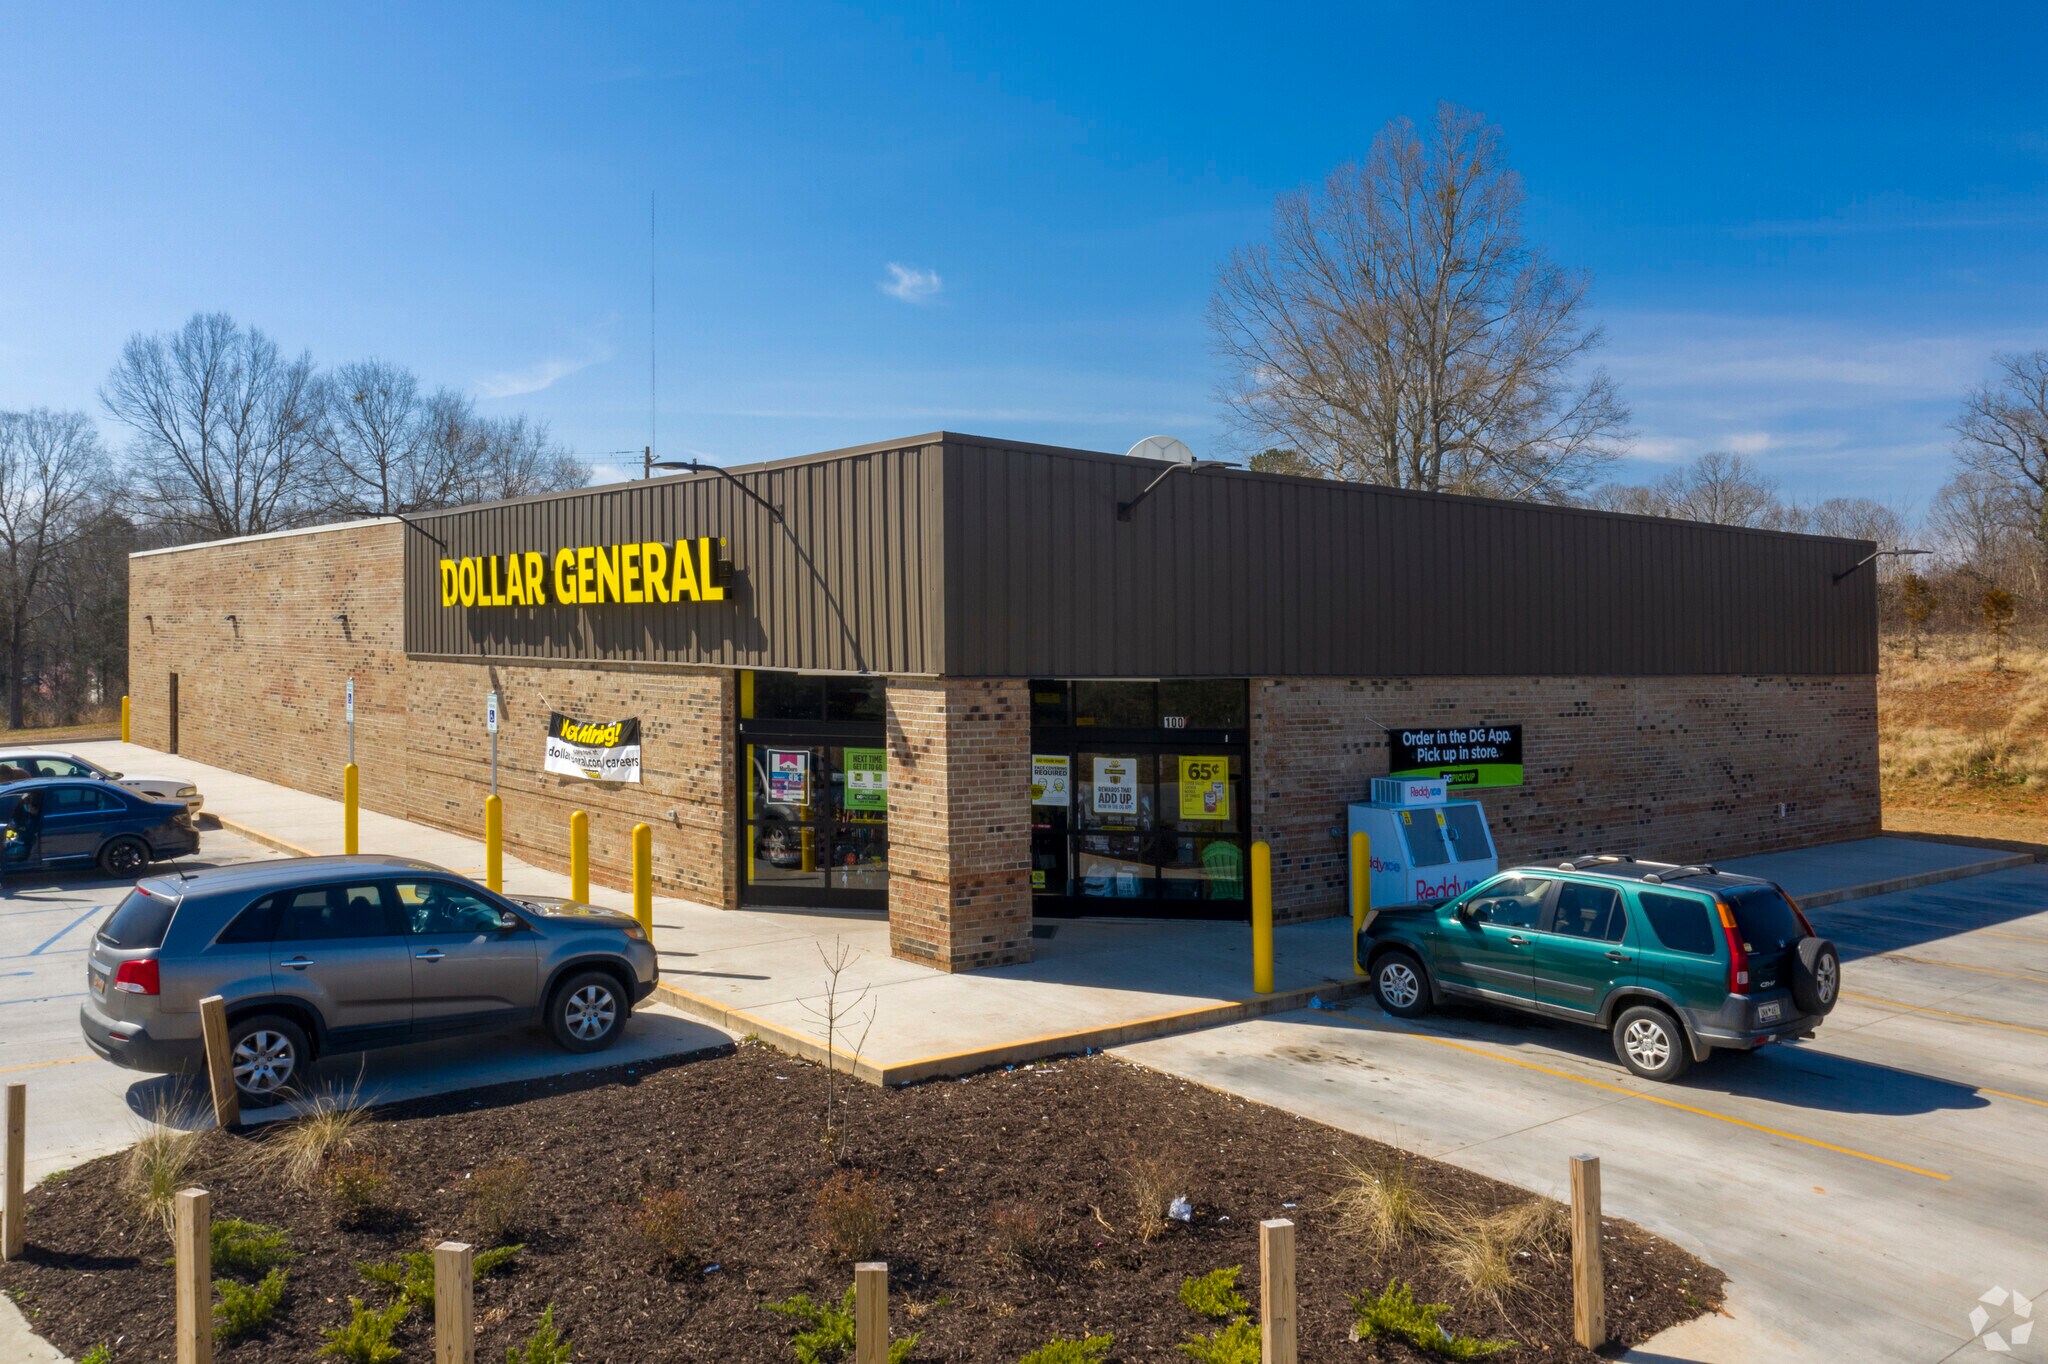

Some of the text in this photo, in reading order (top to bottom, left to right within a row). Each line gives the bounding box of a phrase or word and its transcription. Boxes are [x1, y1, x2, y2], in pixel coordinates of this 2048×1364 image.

[440, 537, 724, 607] DOLLAR GENERAL
[1165, 717, 1184, 728] 100
[1402, 728, 1512, 746] Order in the DG App.
[853, 754, 882, 764] NEXT TIME
[1417, 745, 1499, 763] Pick up in store.
[868, 763, 875, 771] TO
[1034, 769, 1068, 777] REQUIRED
[1188, 762, 1220, 780] 65¢
[1098, 793, 1134, 805] ADD UP.
